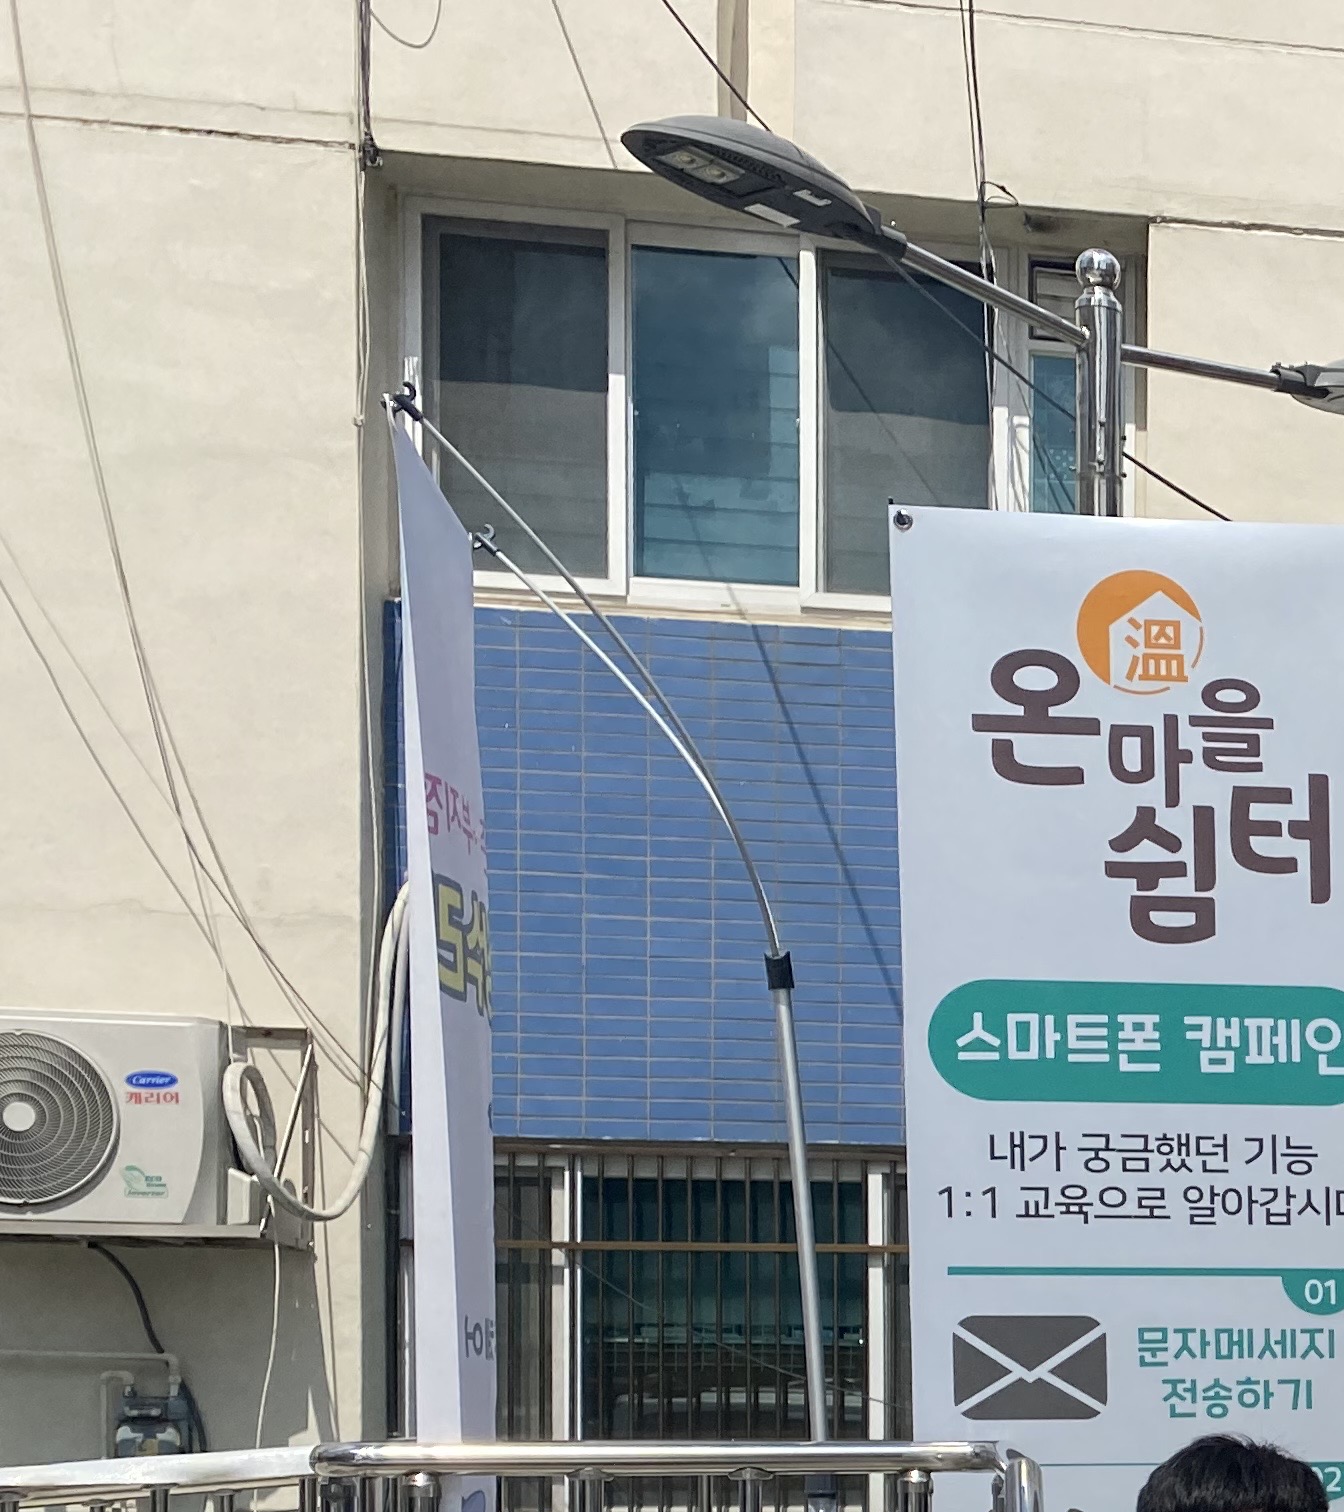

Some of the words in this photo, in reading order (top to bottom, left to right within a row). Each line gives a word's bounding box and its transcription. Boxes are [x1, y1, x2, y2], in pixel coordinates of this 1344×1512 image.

[954, 1010, 1162, 1073] 스마트폰
[987, 1129, 1067, 1172] 내가
[1076, 1131, 1231, 1175] 궁금했던
[1243, 1133, 1319, 1177] 기능
[936, 1185, 1001, 1220] 1:1
[1014, 1183, 1173, 1223] 교육으로
[1303, 1278, 1338, 1306] 01
[1136, 1325, 1337, 1369] 문자메세지
[1160, 1376, 1315, 1420] 전송하기
